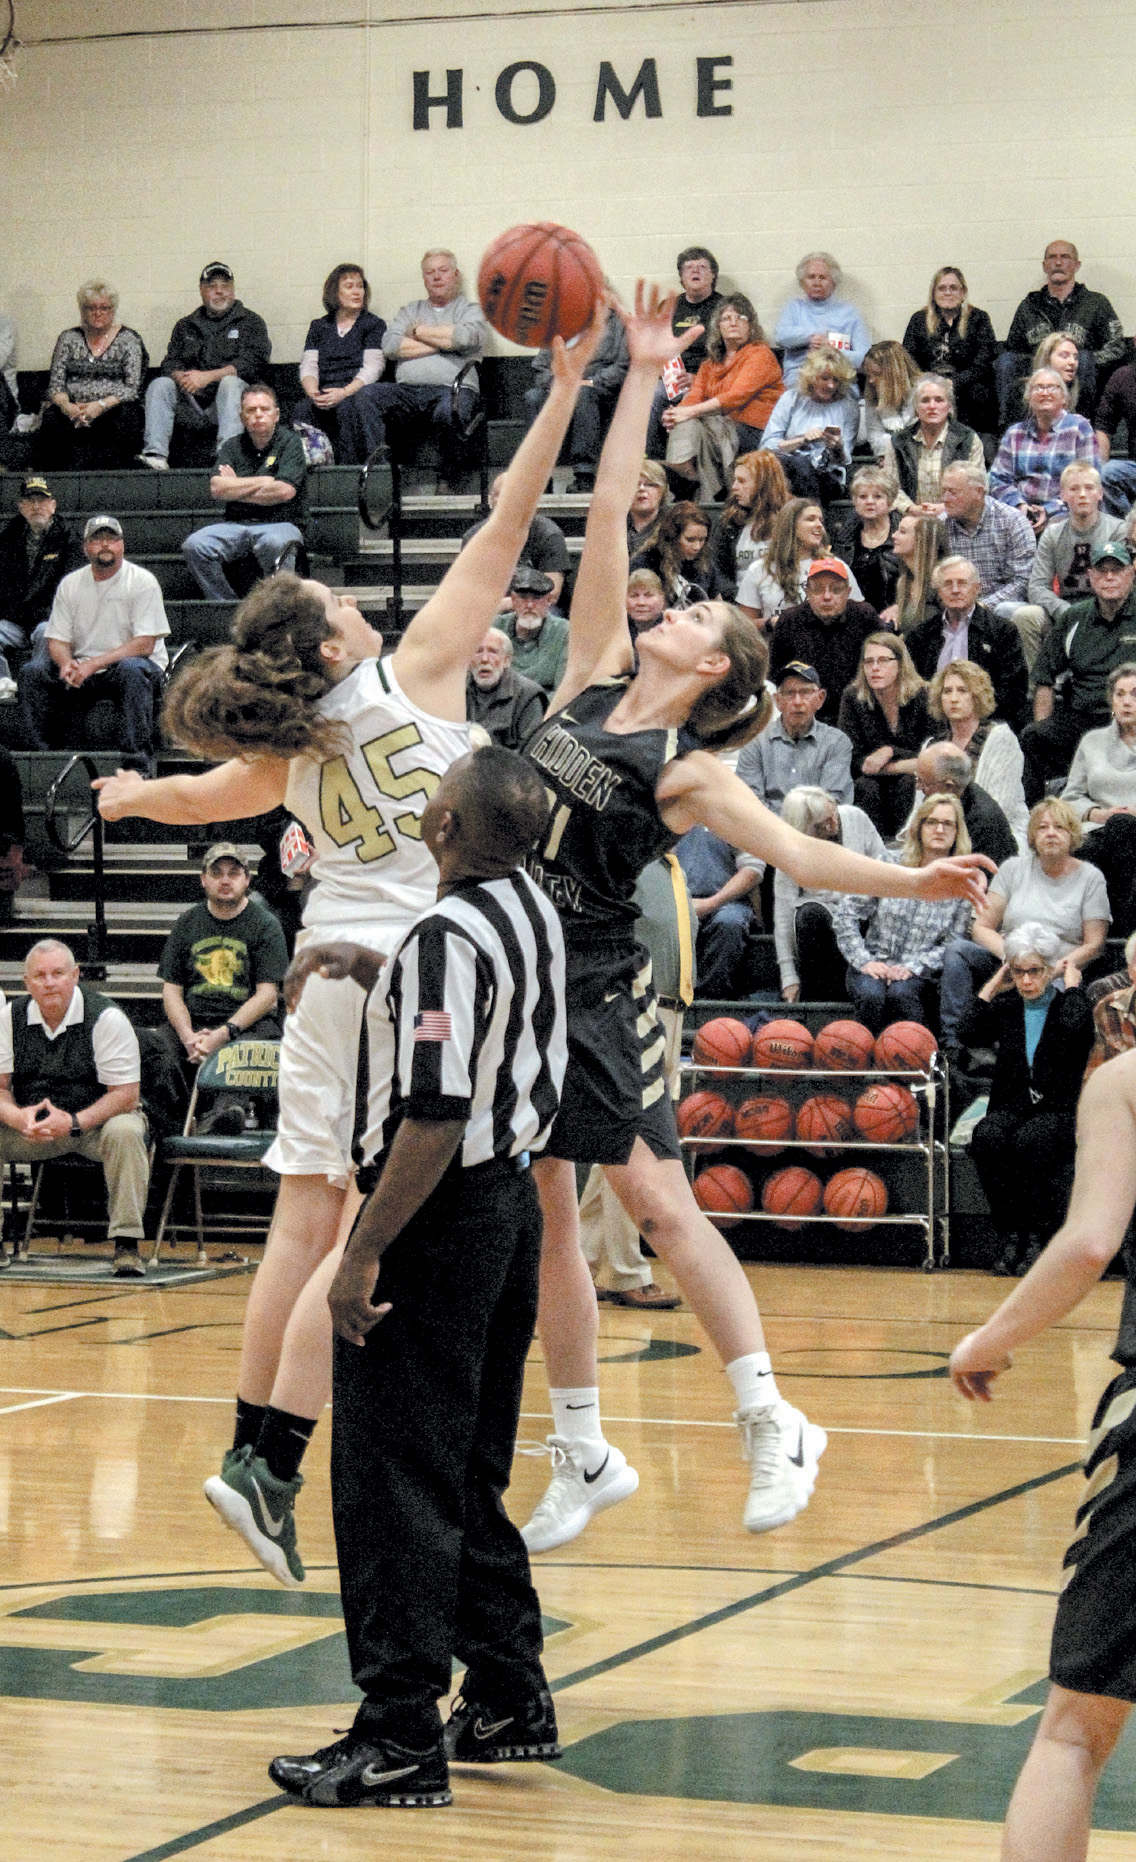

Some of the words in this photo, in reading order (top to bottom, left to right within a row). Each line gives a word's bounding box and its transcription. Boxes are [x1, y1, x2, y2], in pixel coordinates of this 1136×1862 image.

[412, 56, 733, 130] HOME
[318, 721, 442, 865] 45
[530, 723, 623, 812] HIDDEN
[216, 1043, 281, 1075] PATRIC
